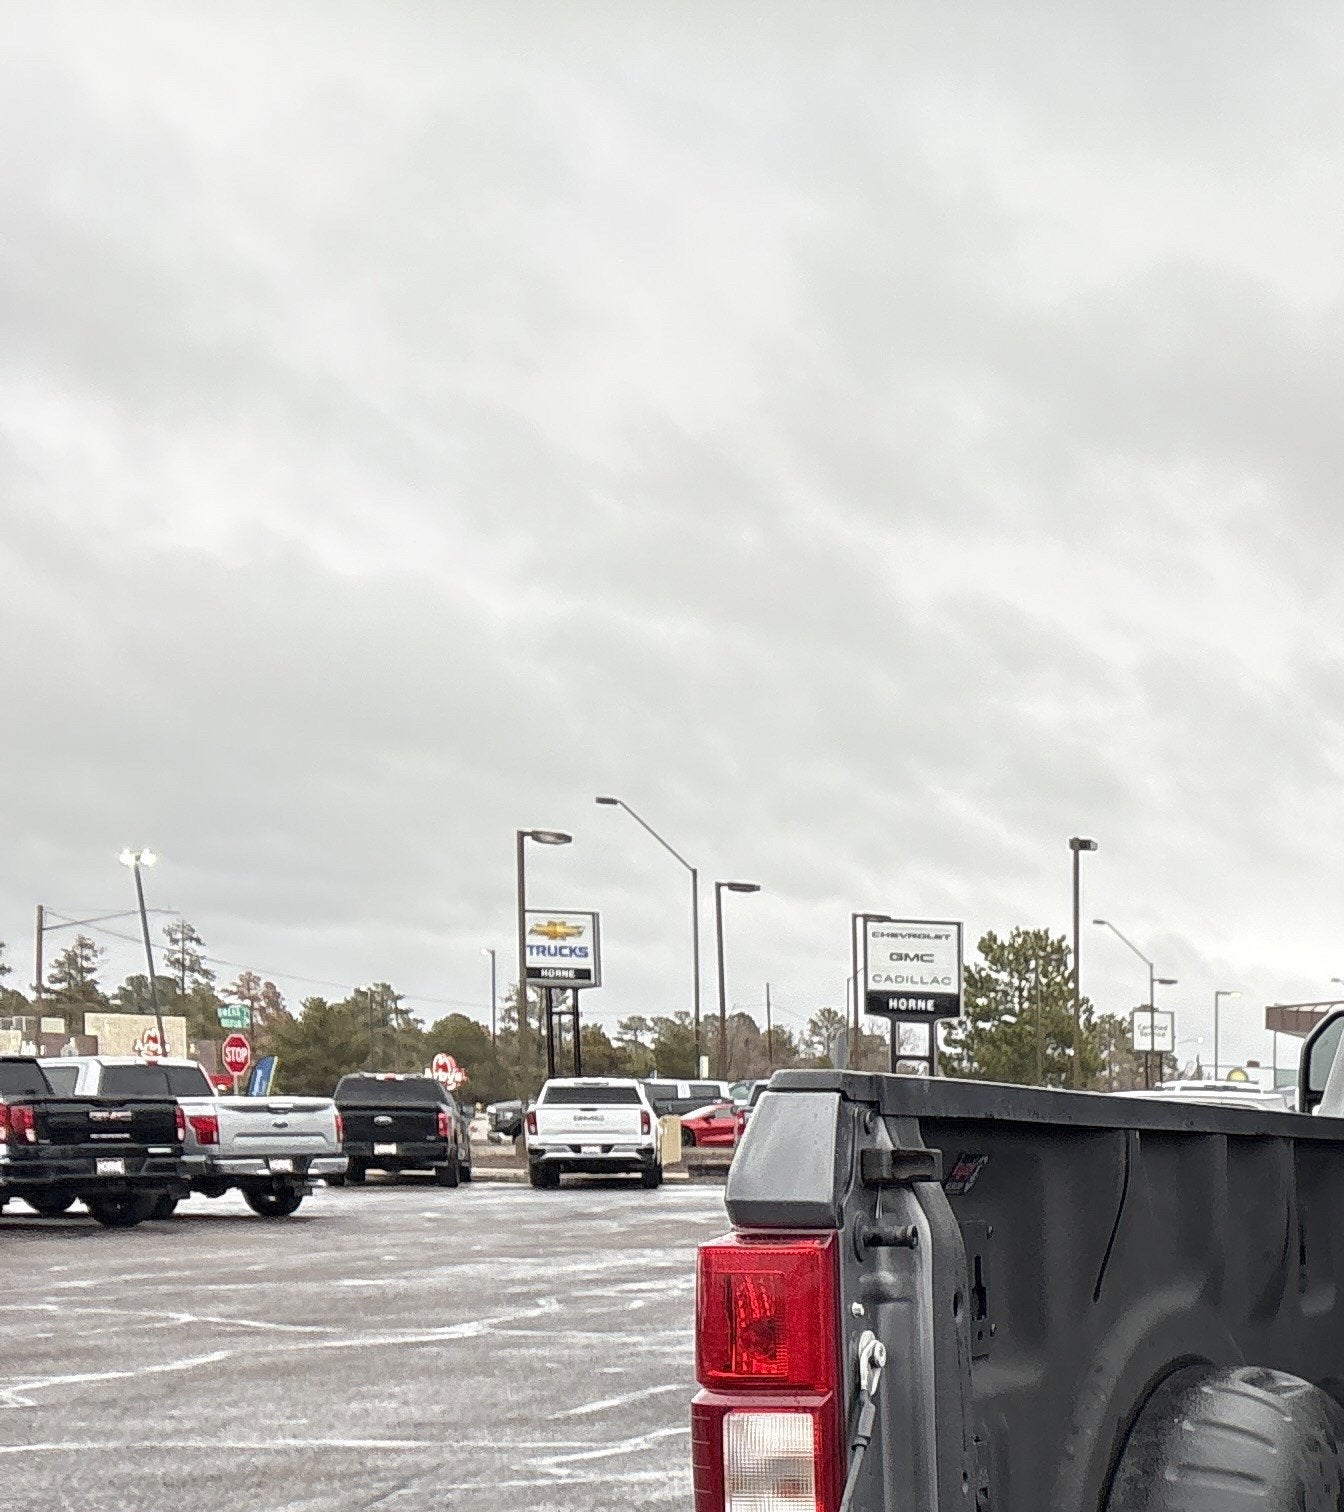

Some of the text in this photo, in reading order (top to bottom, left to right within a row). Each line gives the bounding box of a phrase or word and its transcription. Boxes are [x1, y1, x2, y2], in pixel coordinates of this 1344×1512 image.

[871, 931, 952, 941] CHEVROLET
[526, 944, 589, 958] TRUCKS
[889, 952, 935, 963] GMC
[540, 968, 576, 979] HORNE
[872, 973, 952, 986] CADILLAC
[888, 998, 935, 1012] HORNE
[225, 1046, 248, 1063] STOP
